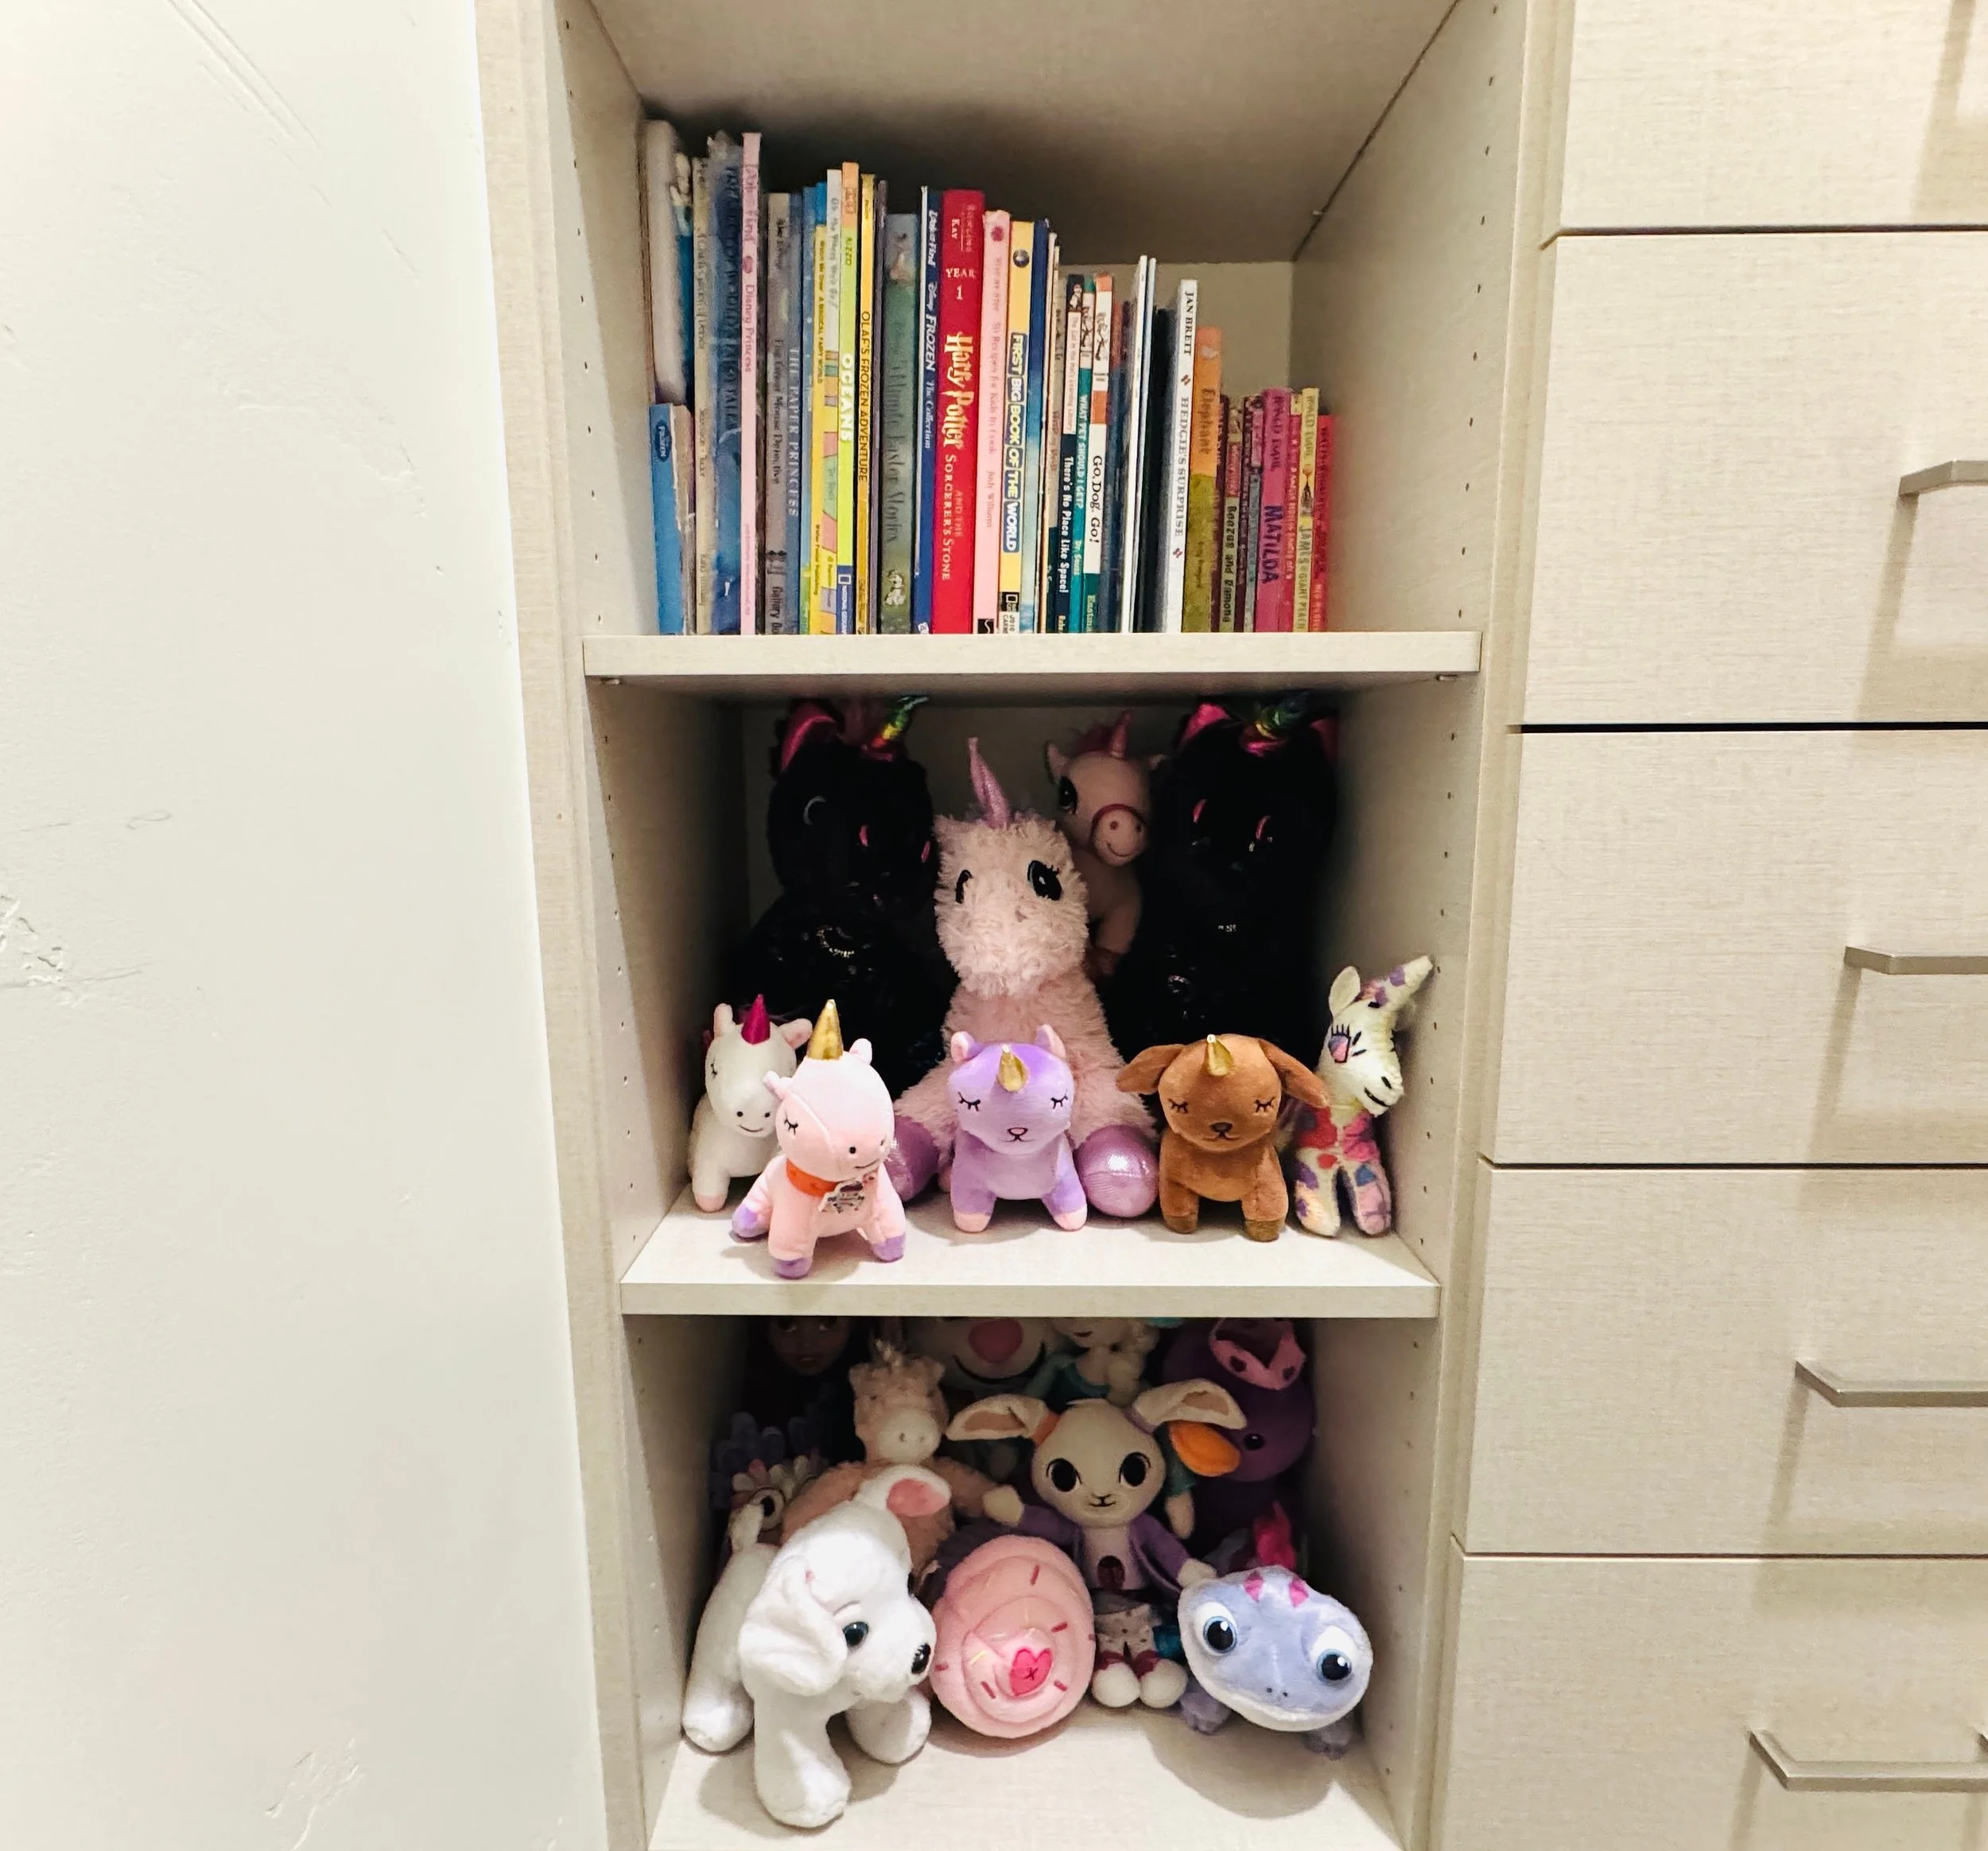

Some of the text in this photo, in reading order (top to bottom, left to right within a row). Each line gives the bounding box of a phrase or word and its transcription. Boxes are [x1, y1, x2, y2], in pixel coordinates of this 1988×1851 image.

[945, 268, 975, 279] YEAR
[955, 285, 964, 301] 1
[743, 284, 755, 324] Disney
[1185, 292, 1194, 313] JAN
[925, 314, 937, 371] FROZEN
[788, 386, 799, 434] PAPER
[840, 352, 855, 442] OCEANS
[859, 311, 871, 482] OLAF'S FROZEN ADVENTURE
[941, 332, 974, 449] Harry Potter
[1079, 394, 1088, 421] WHAT
[1006, 335, 1023, 552] FIRST BIG BOOK OF THE WORLD
[1078, 423, 1087, 440] PET
[788, 442, 799, 517] PRINCESS
[1077, 443, 1086, 478] SHOULD
[1092, 456, 1102, 479] Go,
[1175, 468, 1186, 537] SURPRISE
[1058, 456, 1074, 593] There's No Place Like Space!
[1090, 517, 1100, 543] Go!
[1225, 506, 1237, 549] Beezus
[1262, 505, 1283, 584] MATILDA
[1225, 553, 1234, 573] and
[1223, 580, 1233, 623] Ramona
